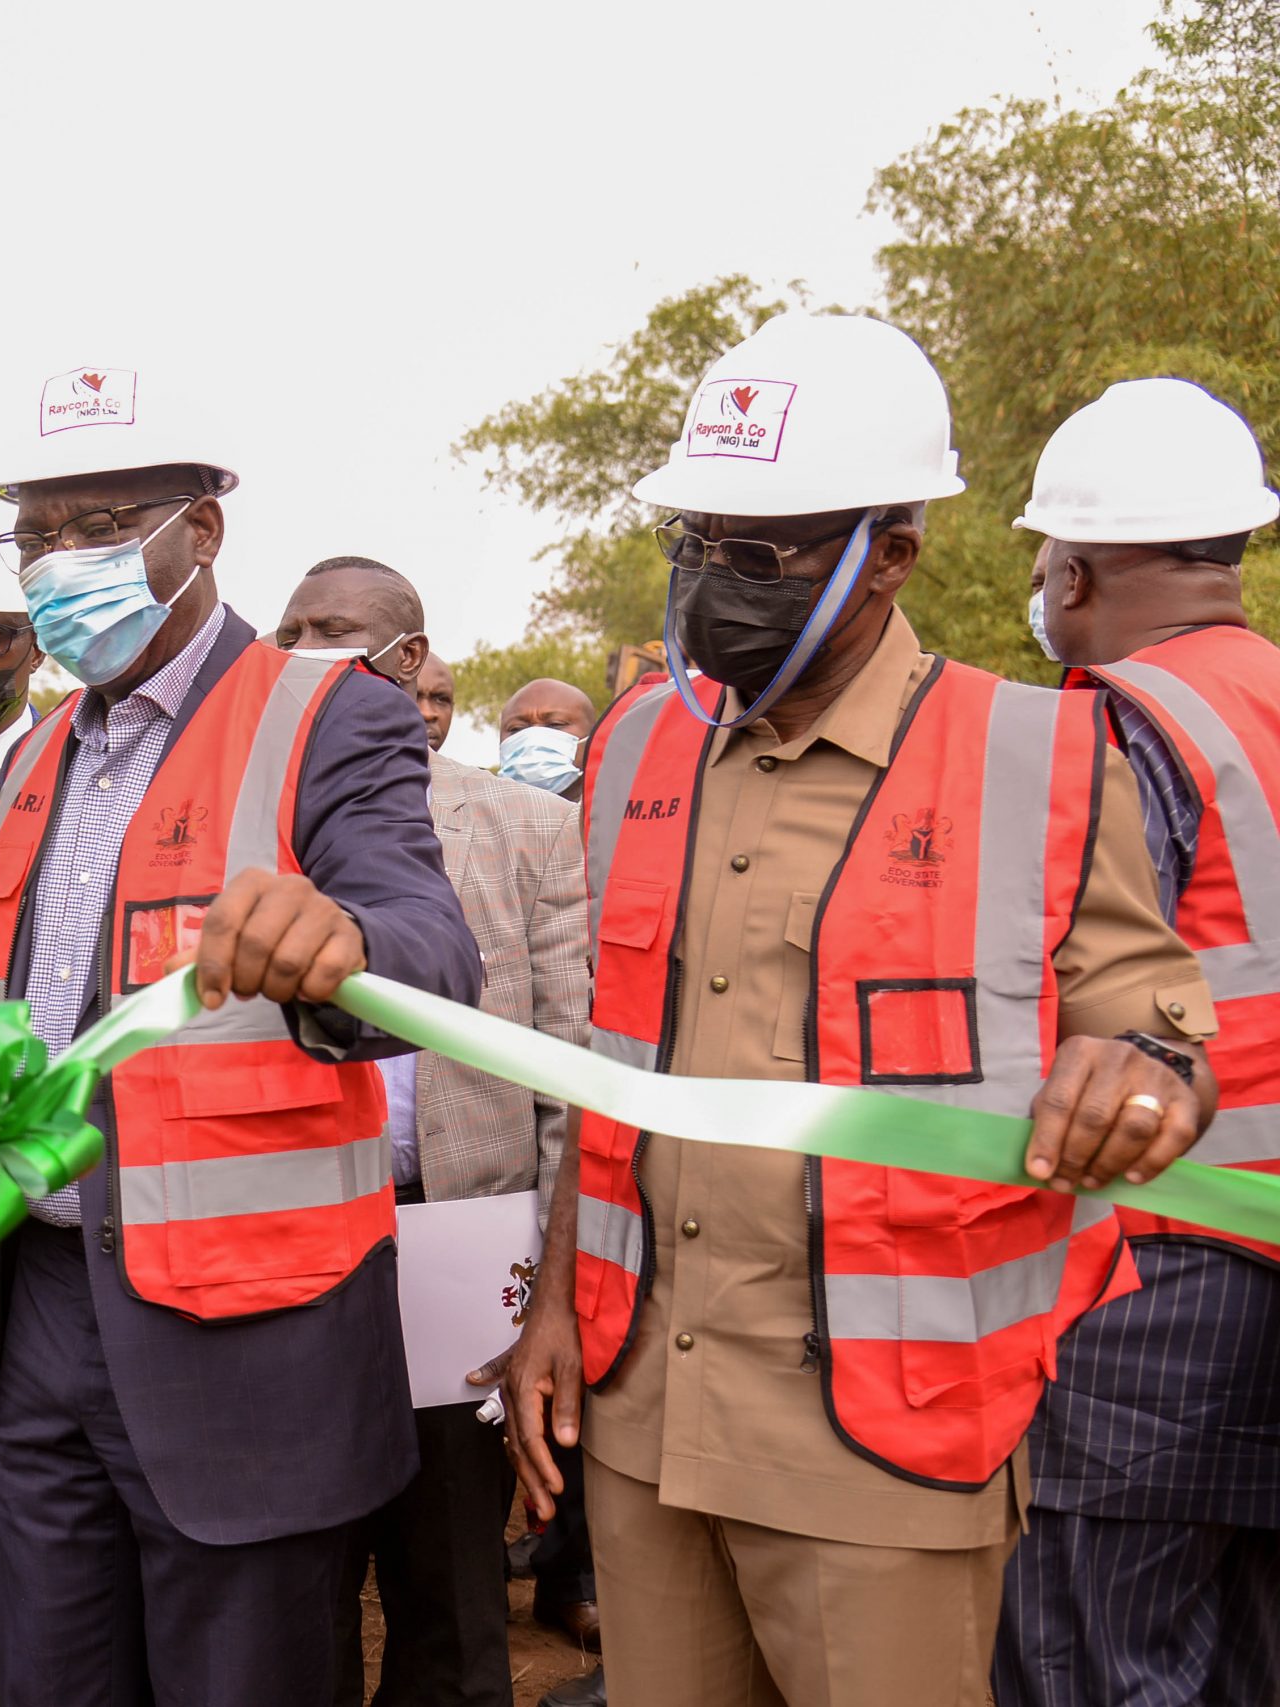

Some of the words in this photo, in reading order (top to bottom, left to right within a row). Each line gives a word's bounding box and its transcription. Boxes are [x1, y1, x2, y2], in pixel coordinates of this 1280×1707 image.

[48, 401, 89, 416] Raycon
[93, 398, 100, 407] &
[105, 398, 121, 408] Co
[696, 423, 732, 437] Raycon
[734, 423, 744, 435] &
[748, 424, 767, 438] Co
[716, 435, 740, 448] (NIG)
[742, 437, 760, 448] Ltd
[623, 797, 681, 820] M.R.B
[888, 866, 912, 878] EDO
